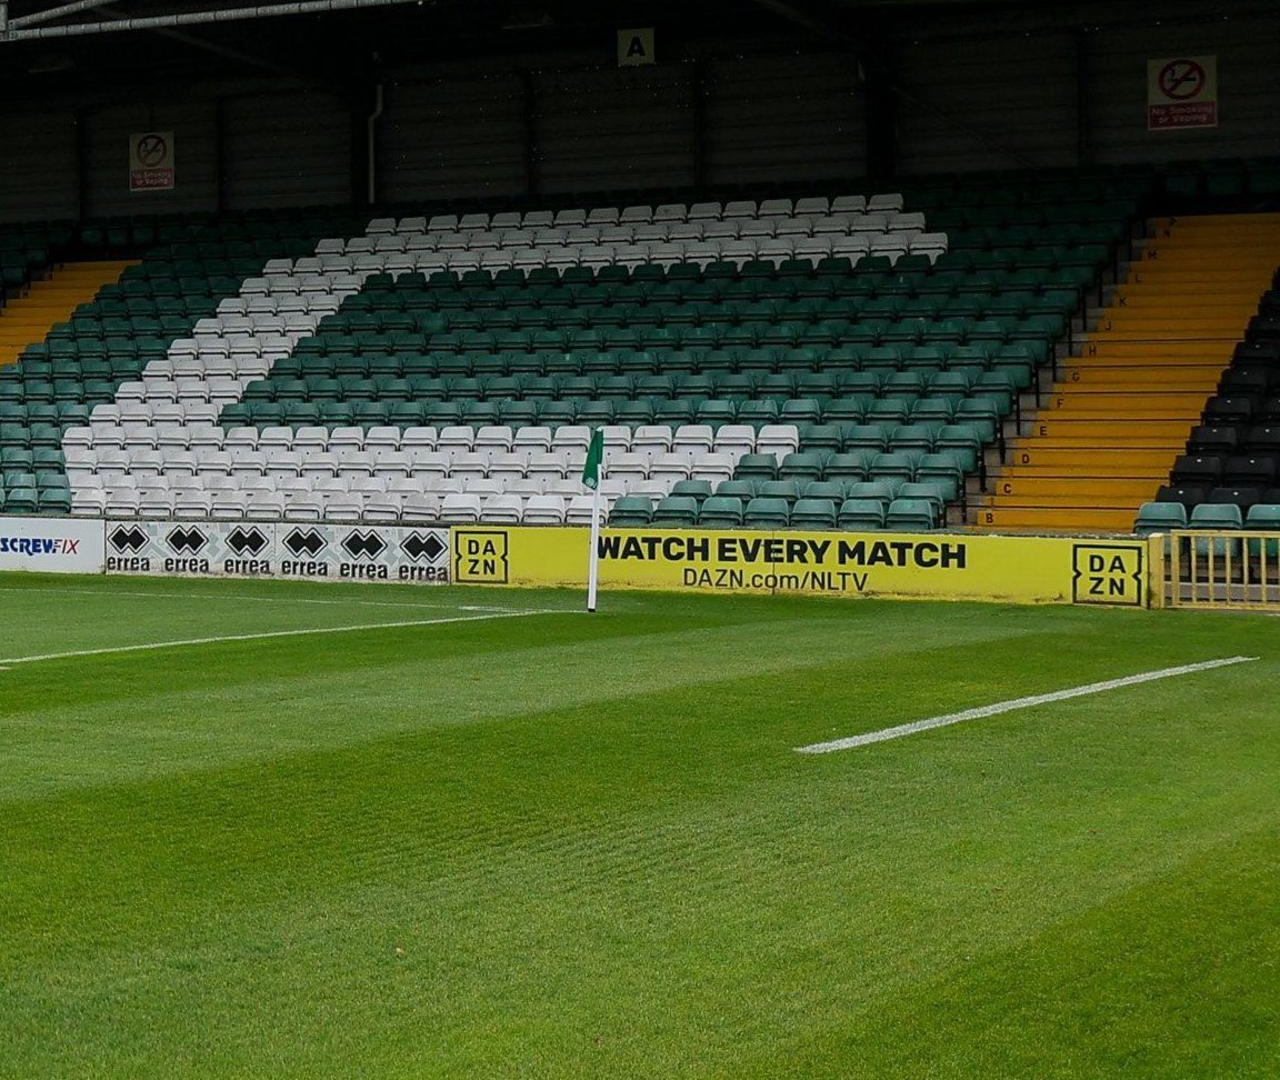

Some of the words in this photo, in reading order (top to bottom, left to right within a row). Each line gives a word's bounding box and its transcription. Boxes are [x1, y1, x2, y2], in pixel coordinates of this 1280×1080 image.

[627, 36, 645, 57] A
[1040, 426, 1047, 435] E
[1022, 454, 1030, 464] D
[1004, 484, 1011, 493] C
[986, 513, 993, 523] B
[0, 537, 79, 556] SCREWFIX
[468, 539, 496, 555] DA
[597, 536, 710, 563] WATCH
[716, 537, 831, 566] EVERY
[838, 540, 967, 569] MATCH
[107, 556, 150, 572] errea
[165, 557, 209, 573] errea
[224, 558, 270, 574] errea
[282, 560, 328, 577] errea
[340, 561, 388, 579] errea
[399, 563, 448, 582] errea
[468, 559, 496, 575] ZN
[1089, 555, 1126, 574] DA
[683, 568, 868, 593] DAZN.com/NLTV
[1089, 577, 1126, 596] ZN
